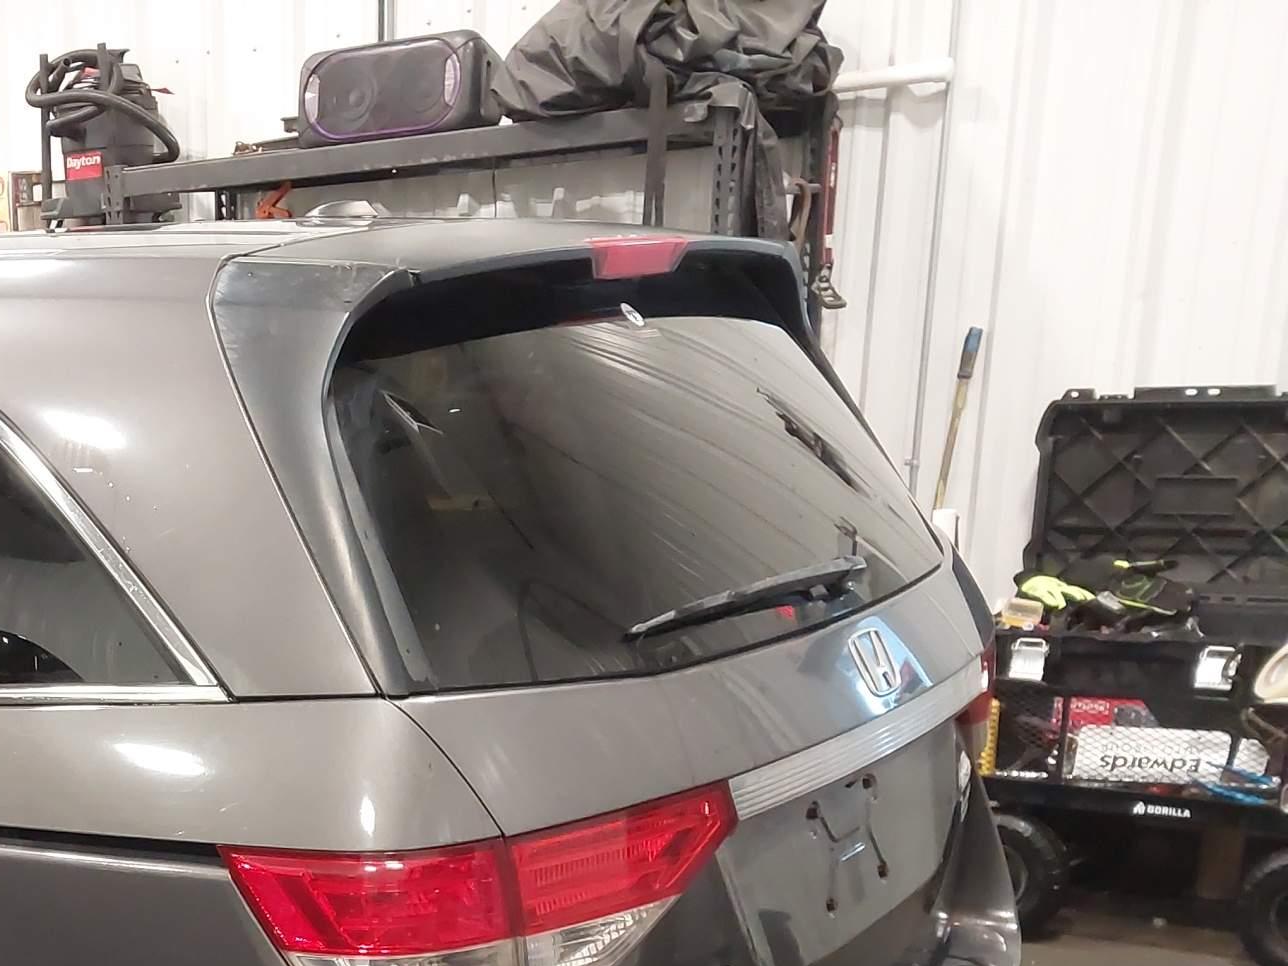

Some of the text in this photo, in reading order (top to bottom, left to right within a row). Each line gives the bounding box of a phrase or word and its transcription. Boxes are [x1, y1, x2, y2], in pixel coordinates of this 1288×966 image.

[66, 155, 101, 170] Dayton
[1099, 754, 1202, 774] Edwards
[1146, 804, 1191, 818] GORILLA
